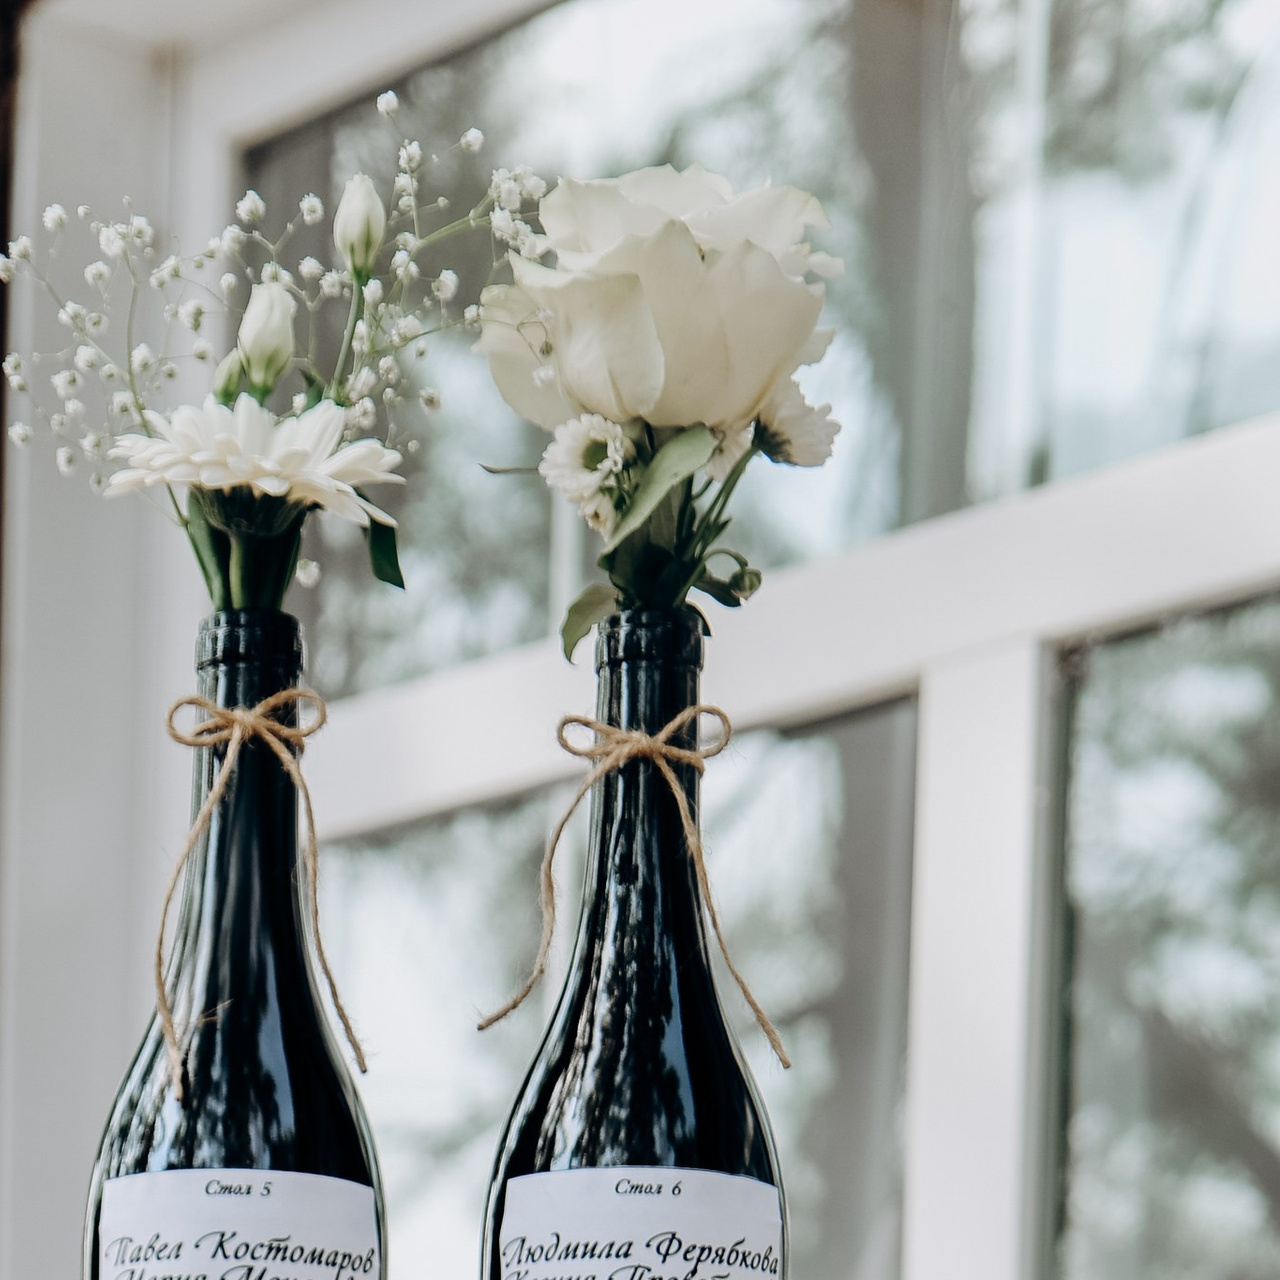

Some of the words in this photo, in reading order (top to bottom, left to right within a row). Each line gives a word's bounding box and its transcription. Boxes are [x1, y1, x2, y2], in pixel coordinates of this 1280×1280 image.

[205, 1180, 252, 1195] Стол
[260, 1181, 272, 1195] 5
[615, 1179, 663, 1195] Стол
[672, 1181, 682, 1196] 6
[105, 1233, 183, 1266] Павел
[194, 1231, 375, 1280] Костомаров
[502, 1233, 634, 1267] Людмила
